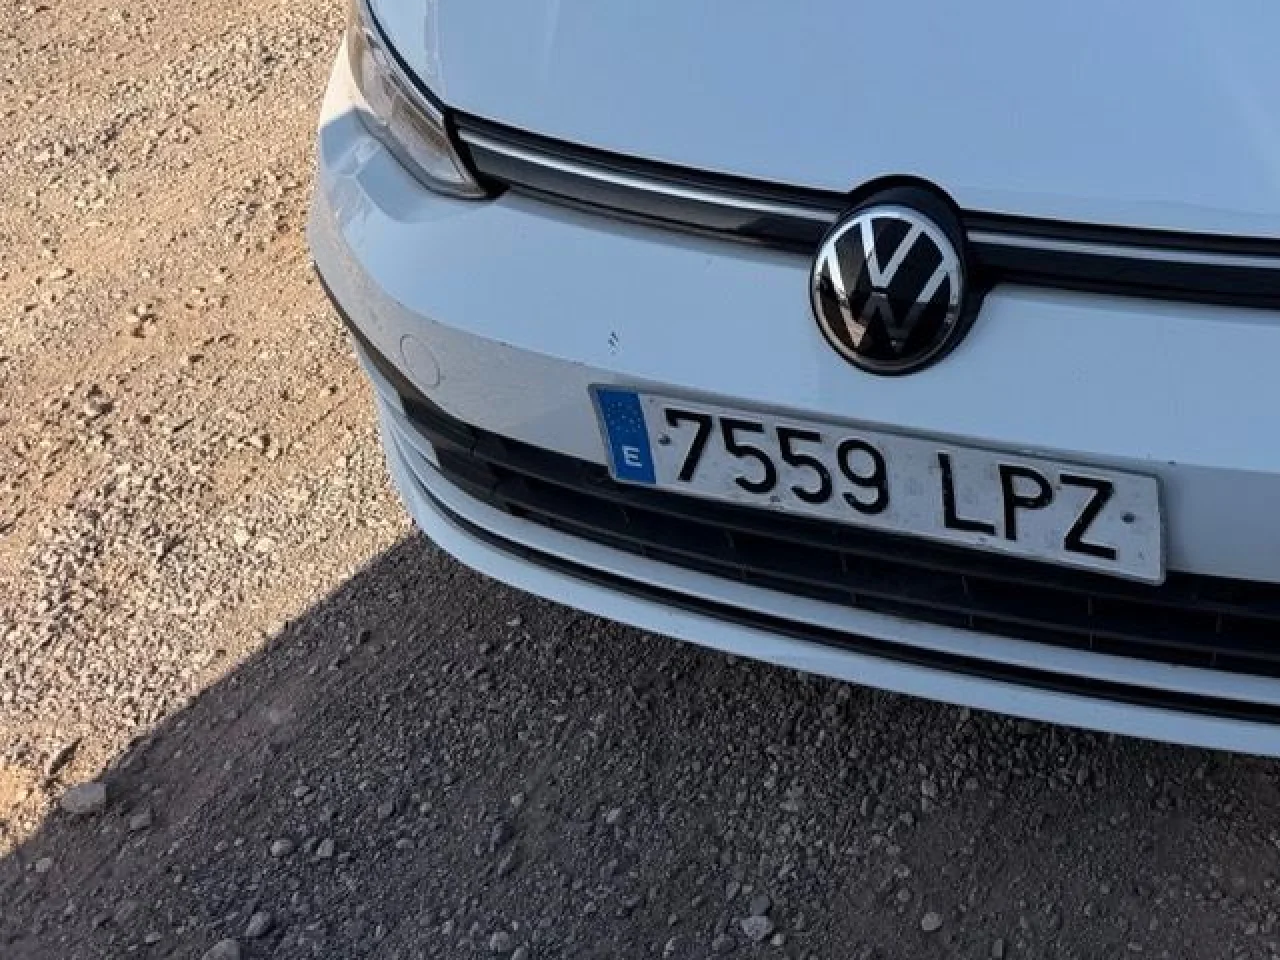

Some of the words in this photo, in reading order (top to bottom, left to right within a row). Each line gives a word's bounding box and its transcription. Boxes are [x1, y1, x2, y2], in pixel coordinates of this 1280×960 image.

[621, 444, 643, 469] E
[664, 407, 890, 516] 7559
[936, 451, 1118, 561] LPZ
